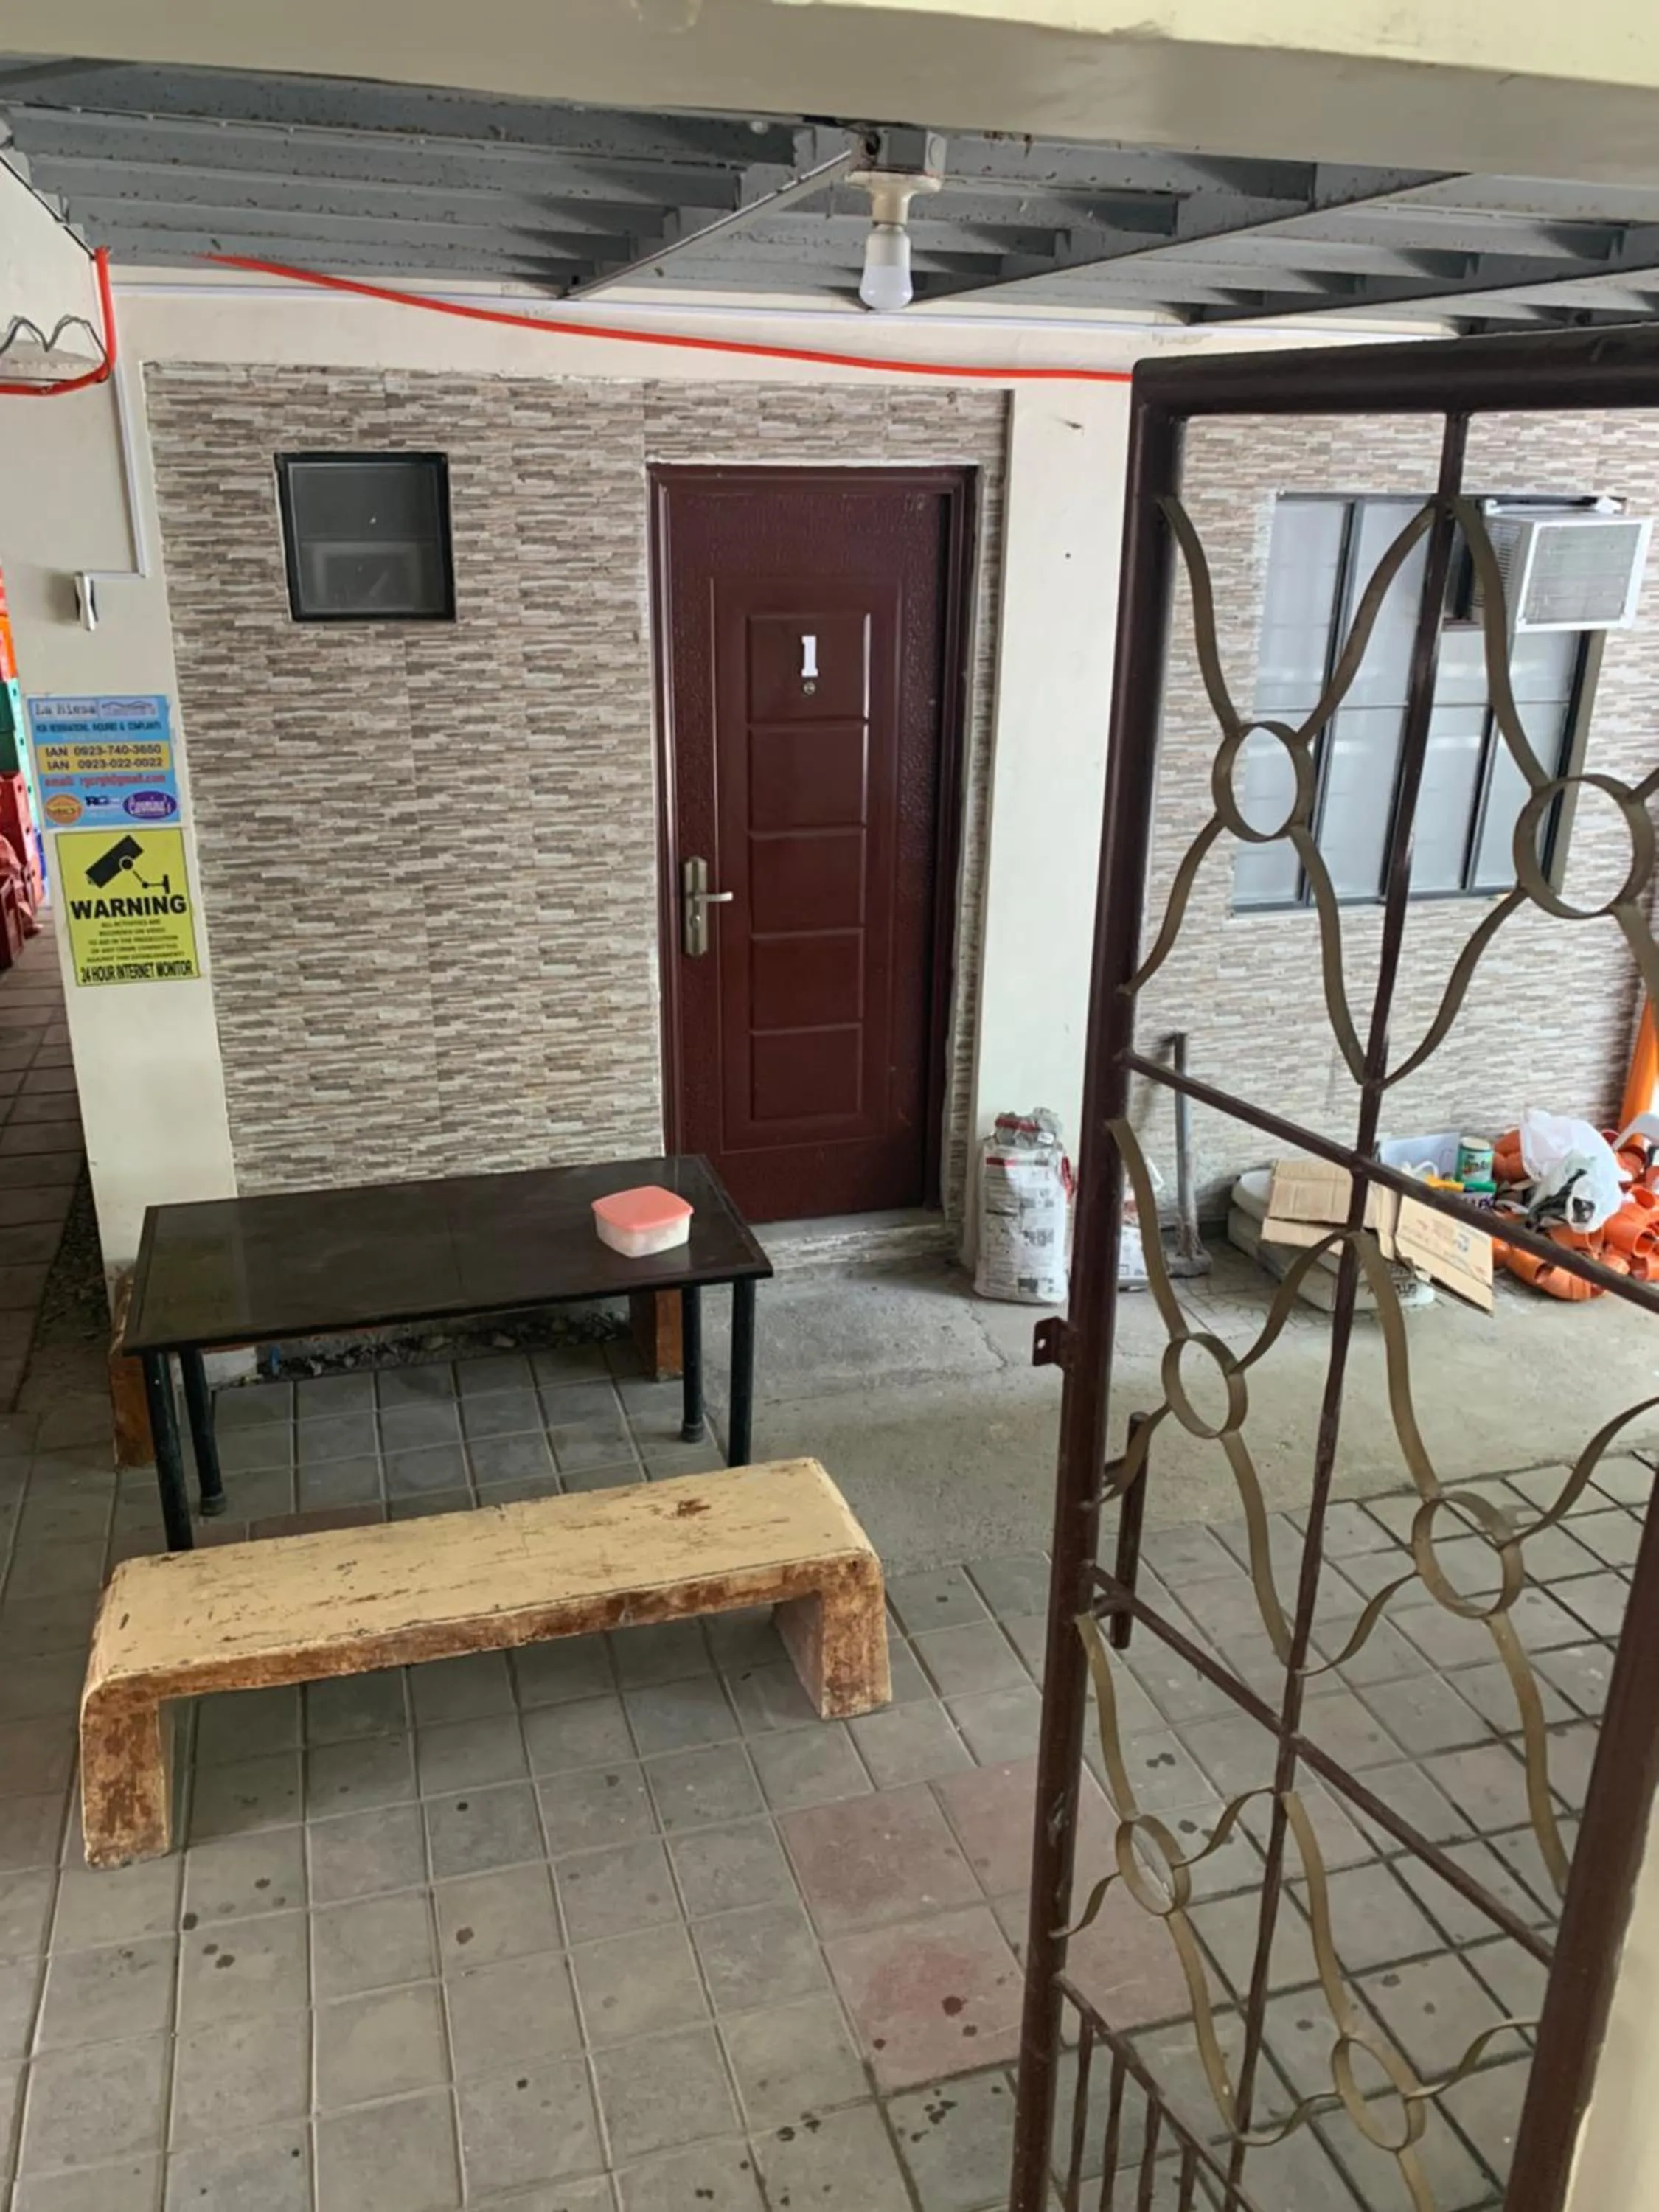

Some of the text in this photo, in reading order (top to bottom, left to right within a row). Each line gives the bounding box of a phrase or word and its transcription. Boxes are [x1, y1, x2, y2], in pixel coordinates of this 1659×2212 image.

[70, 894, 187, 920] WARNING
[91, 964, 116, 982] HOUR
[116, 961, 154, 980] INTERNET
[156, 959, 194, 977] MONITOR
